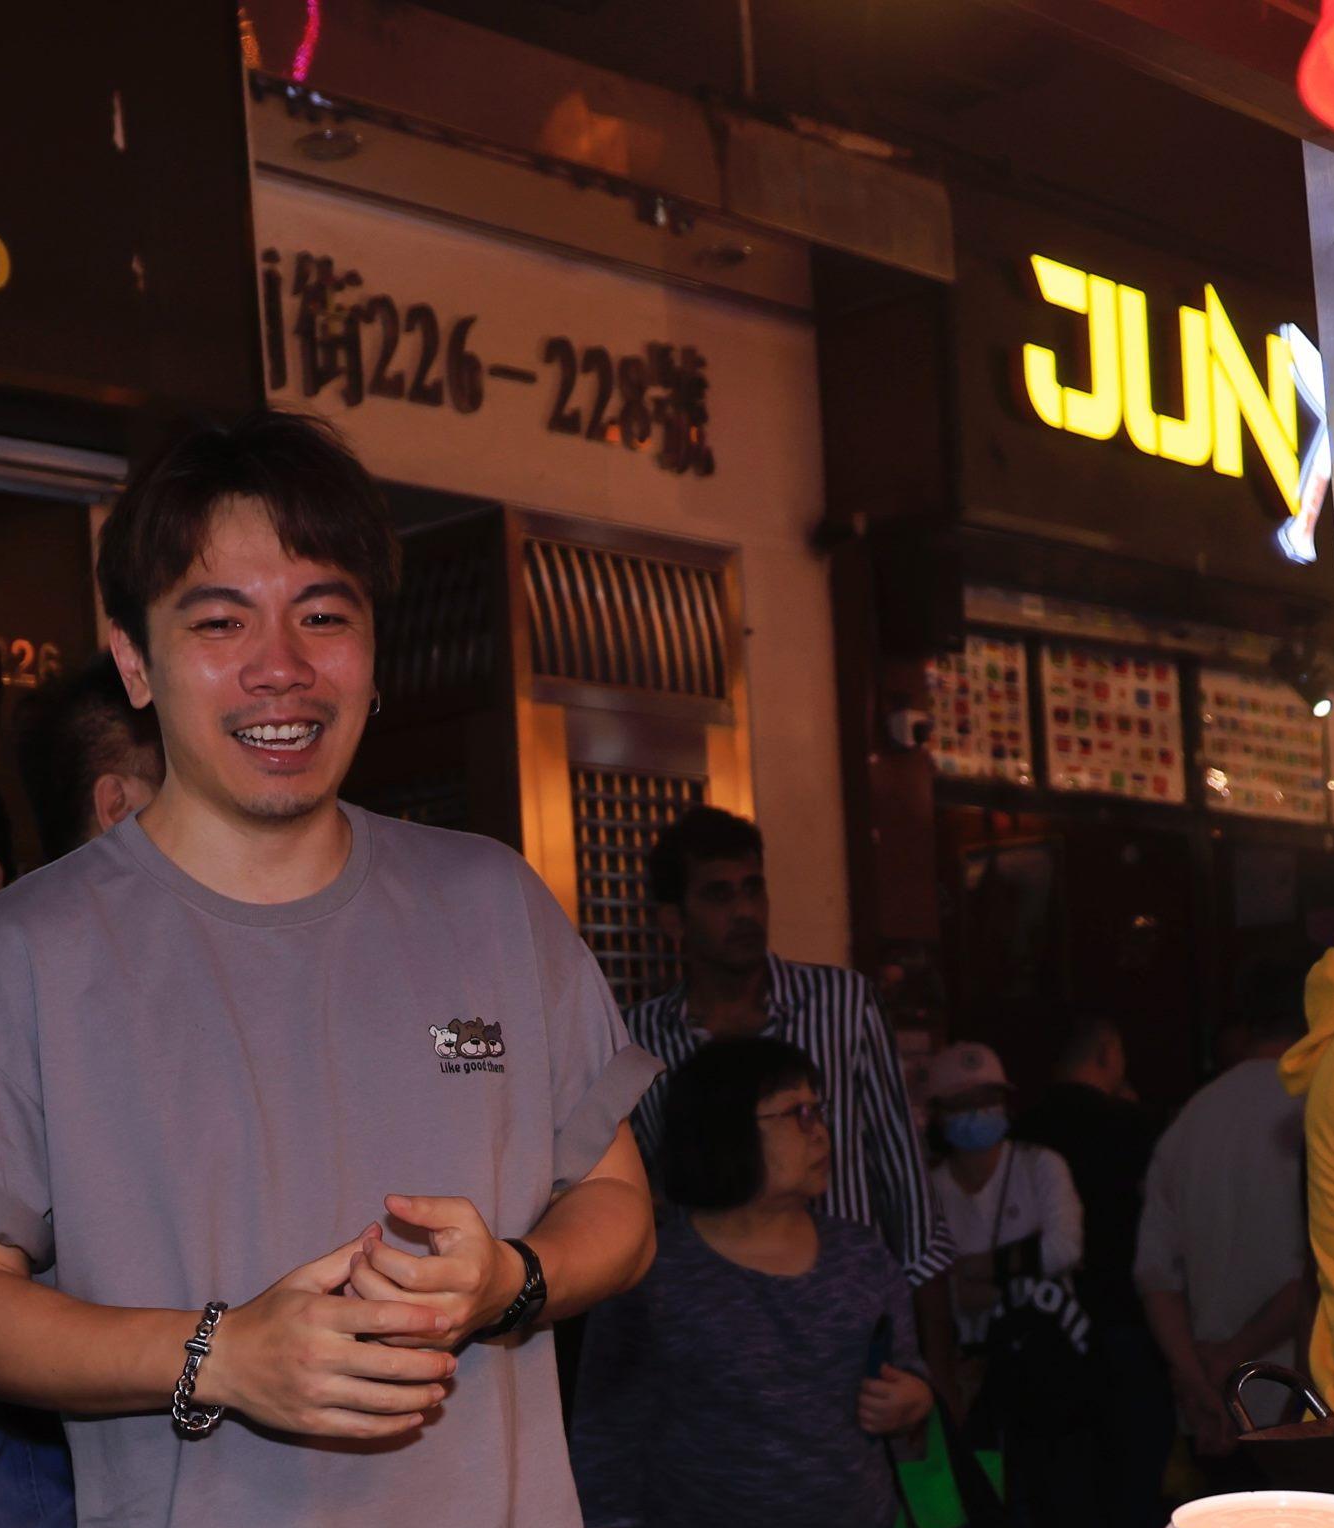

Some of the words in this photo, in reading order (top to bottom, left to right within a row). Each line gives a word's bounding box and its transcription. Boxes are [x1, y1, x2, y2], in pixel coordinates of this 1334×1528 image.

[440, 1062, 461, 1074] Like
[464, 1061, 487, 1074] good
[487, 1061, 505, 1074] them
